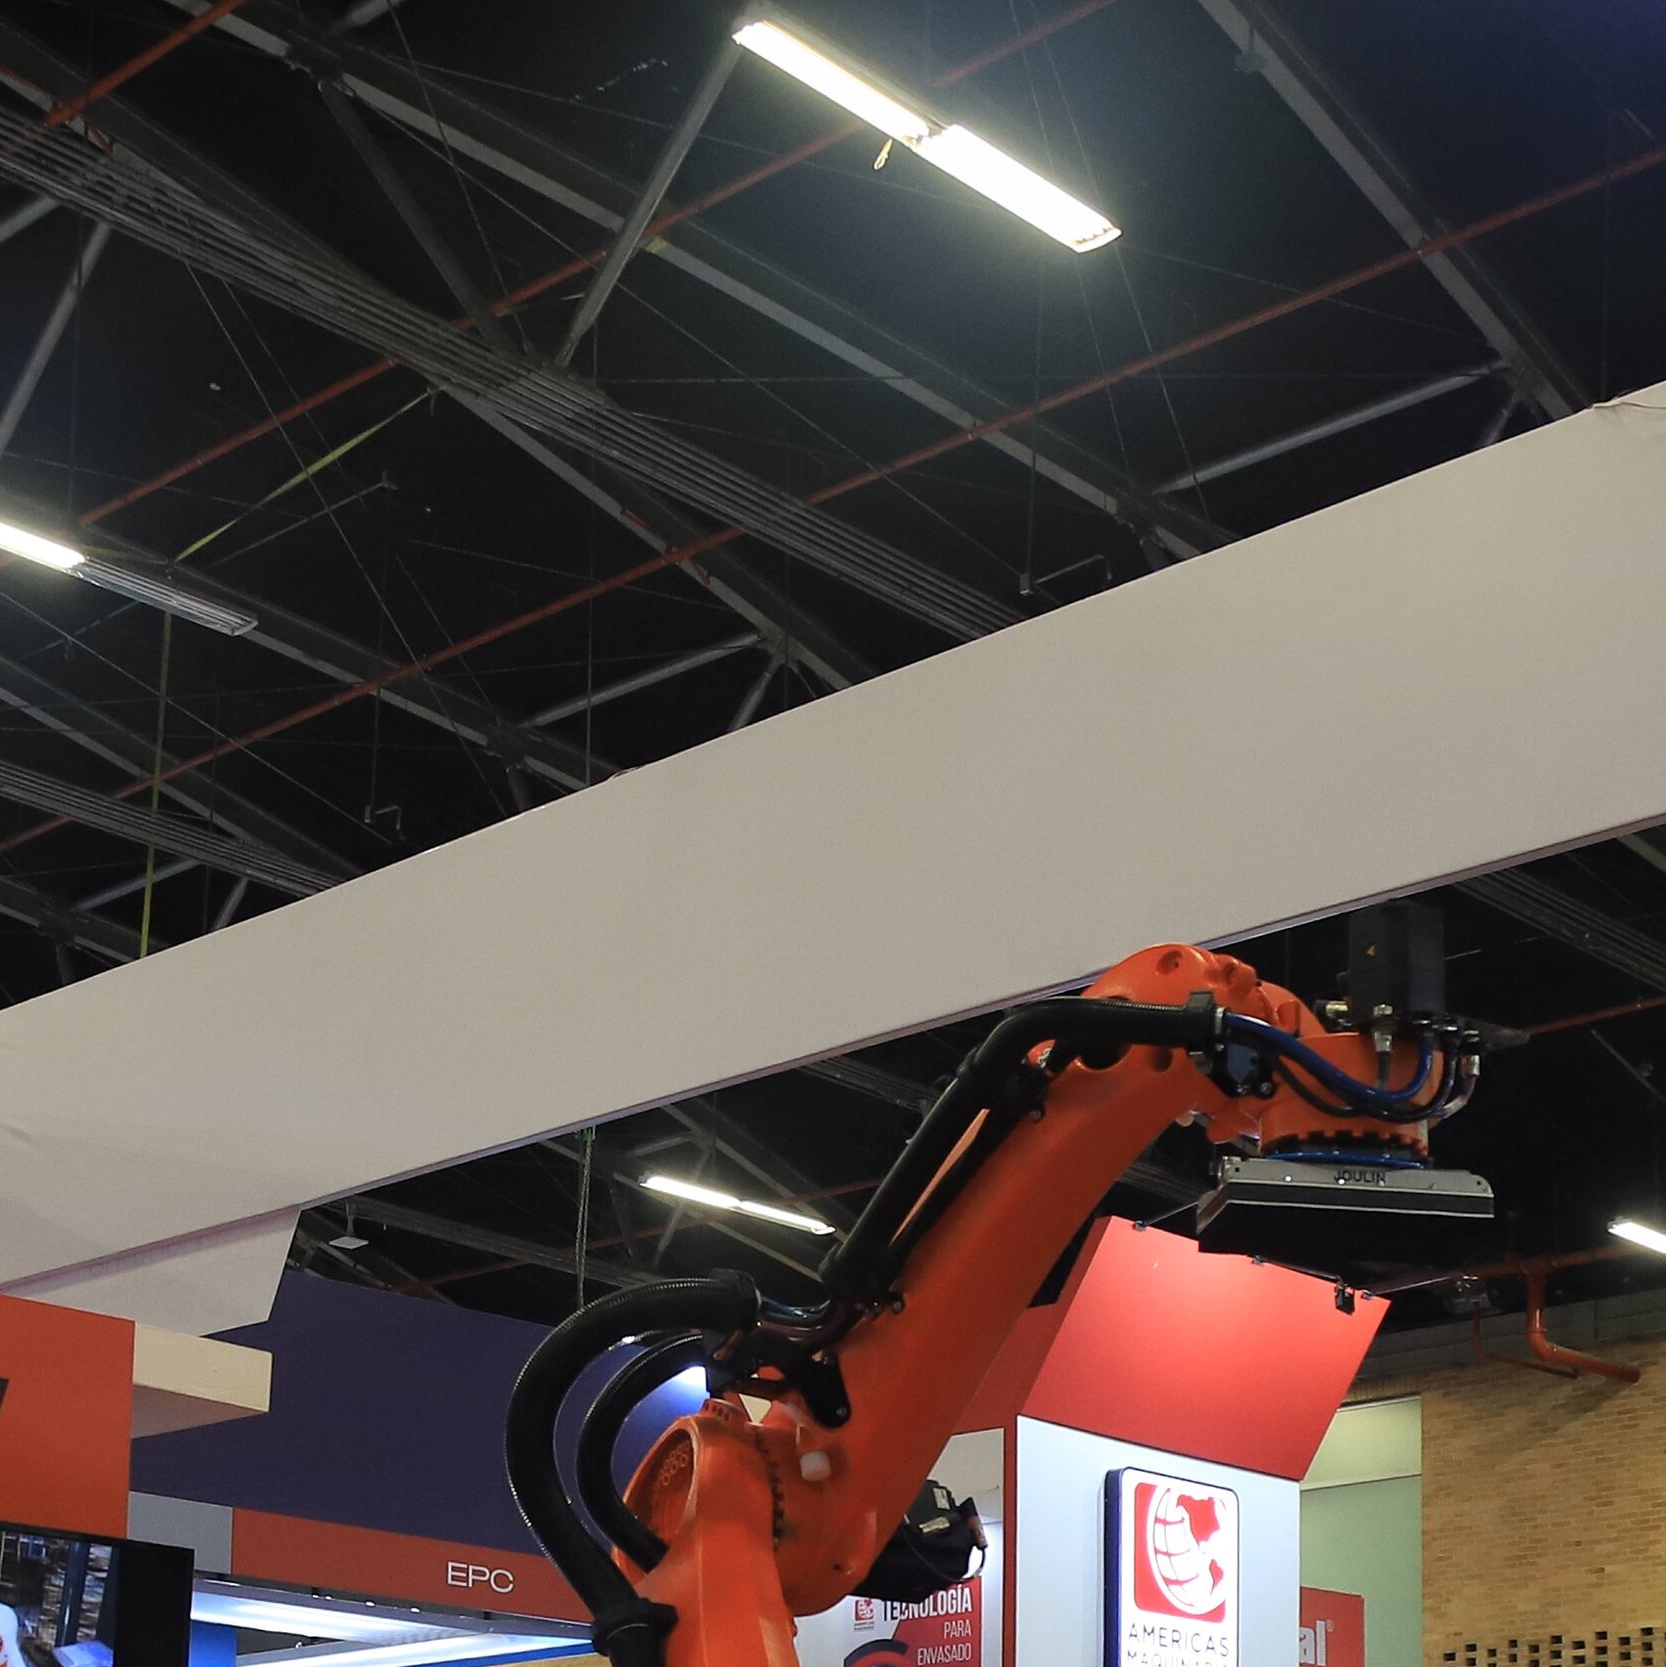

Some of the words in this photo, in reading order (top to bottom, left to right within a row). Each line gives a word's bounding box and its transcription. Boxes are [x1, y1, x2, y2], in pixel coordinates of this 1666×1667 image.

[446, 1560, 515, 1594] EPC
[944, 1619, 972, 1640] PARA
[1128, 1622, 1230, 1657] AMERICAS
[917, 1648, 973, 1667] ENVASADO
